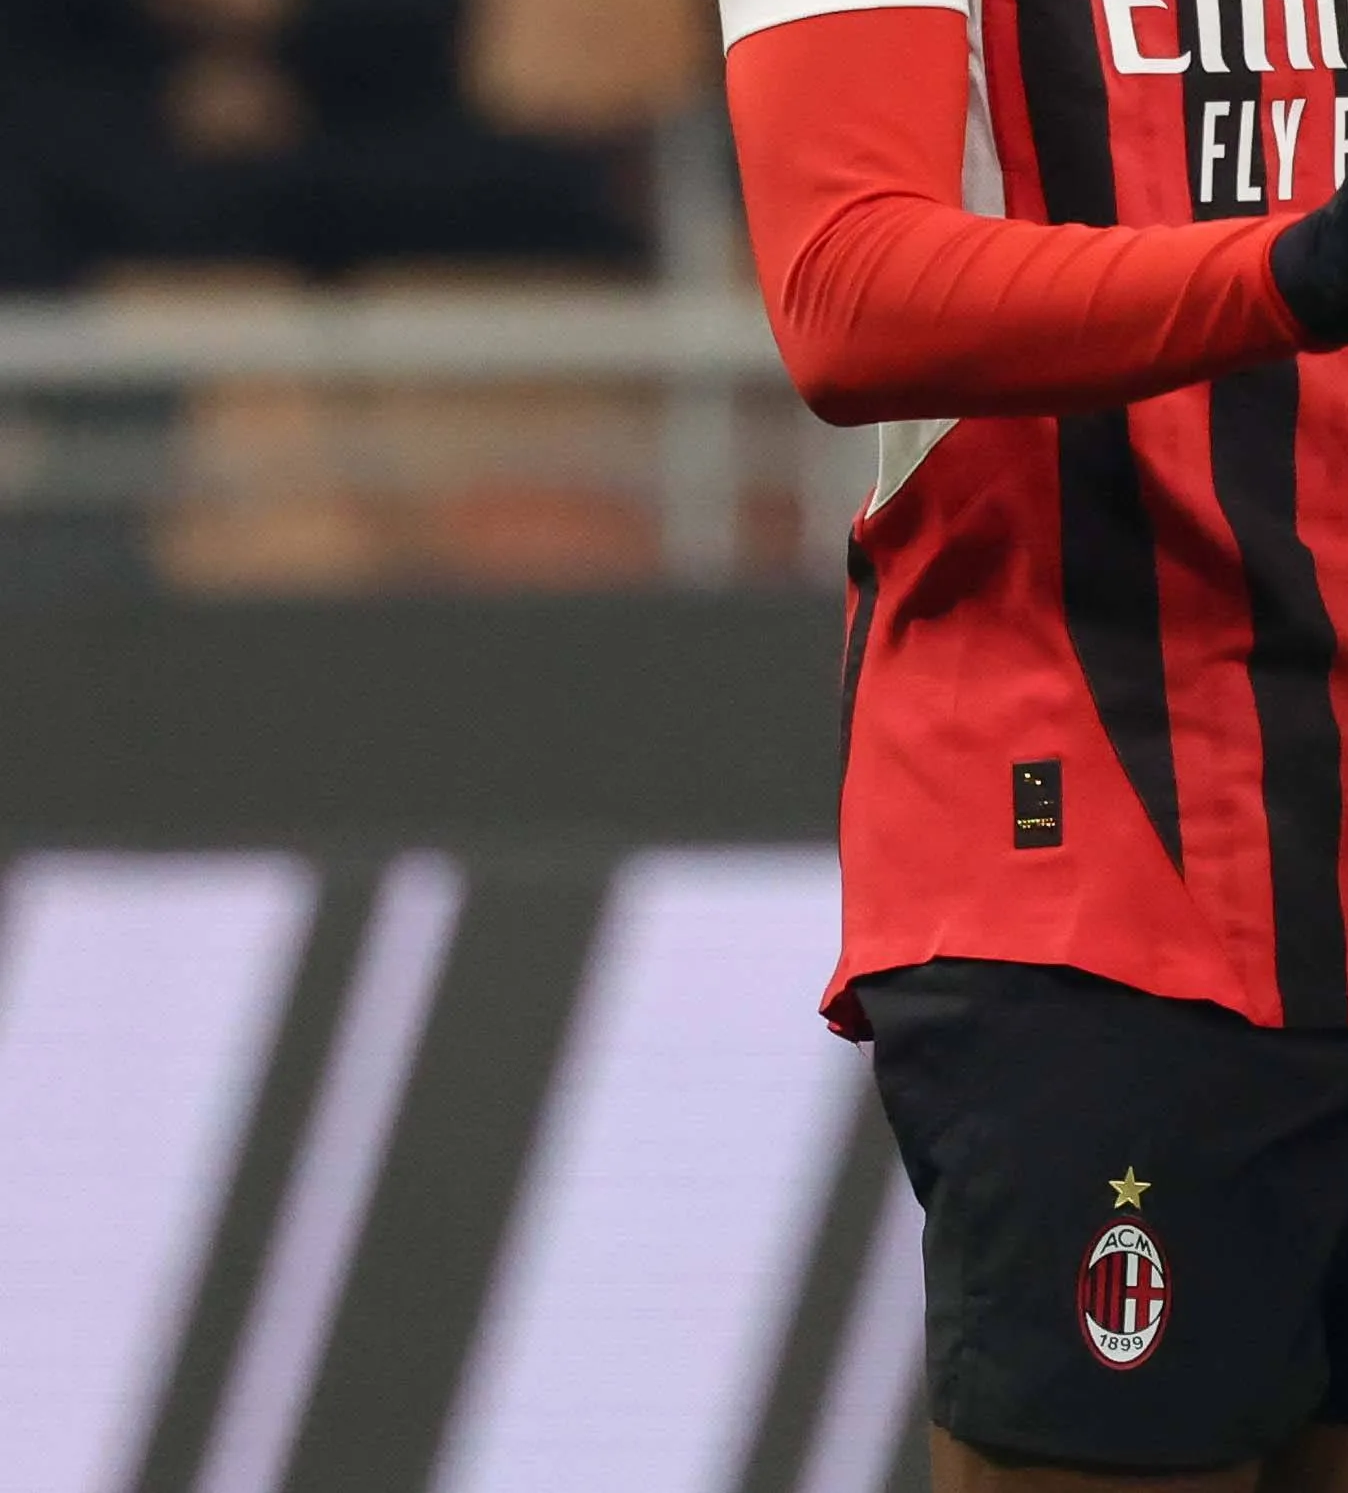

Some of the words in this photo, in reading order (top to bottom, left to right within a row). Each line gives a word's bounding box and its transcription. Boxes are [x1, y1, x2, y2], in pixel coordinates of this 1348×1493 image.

[1200, 97, 1306, 203] FLY
[1101, 1229, 1153, 1259] ACM
[1100, 1333, 1144, 1352] 1899
